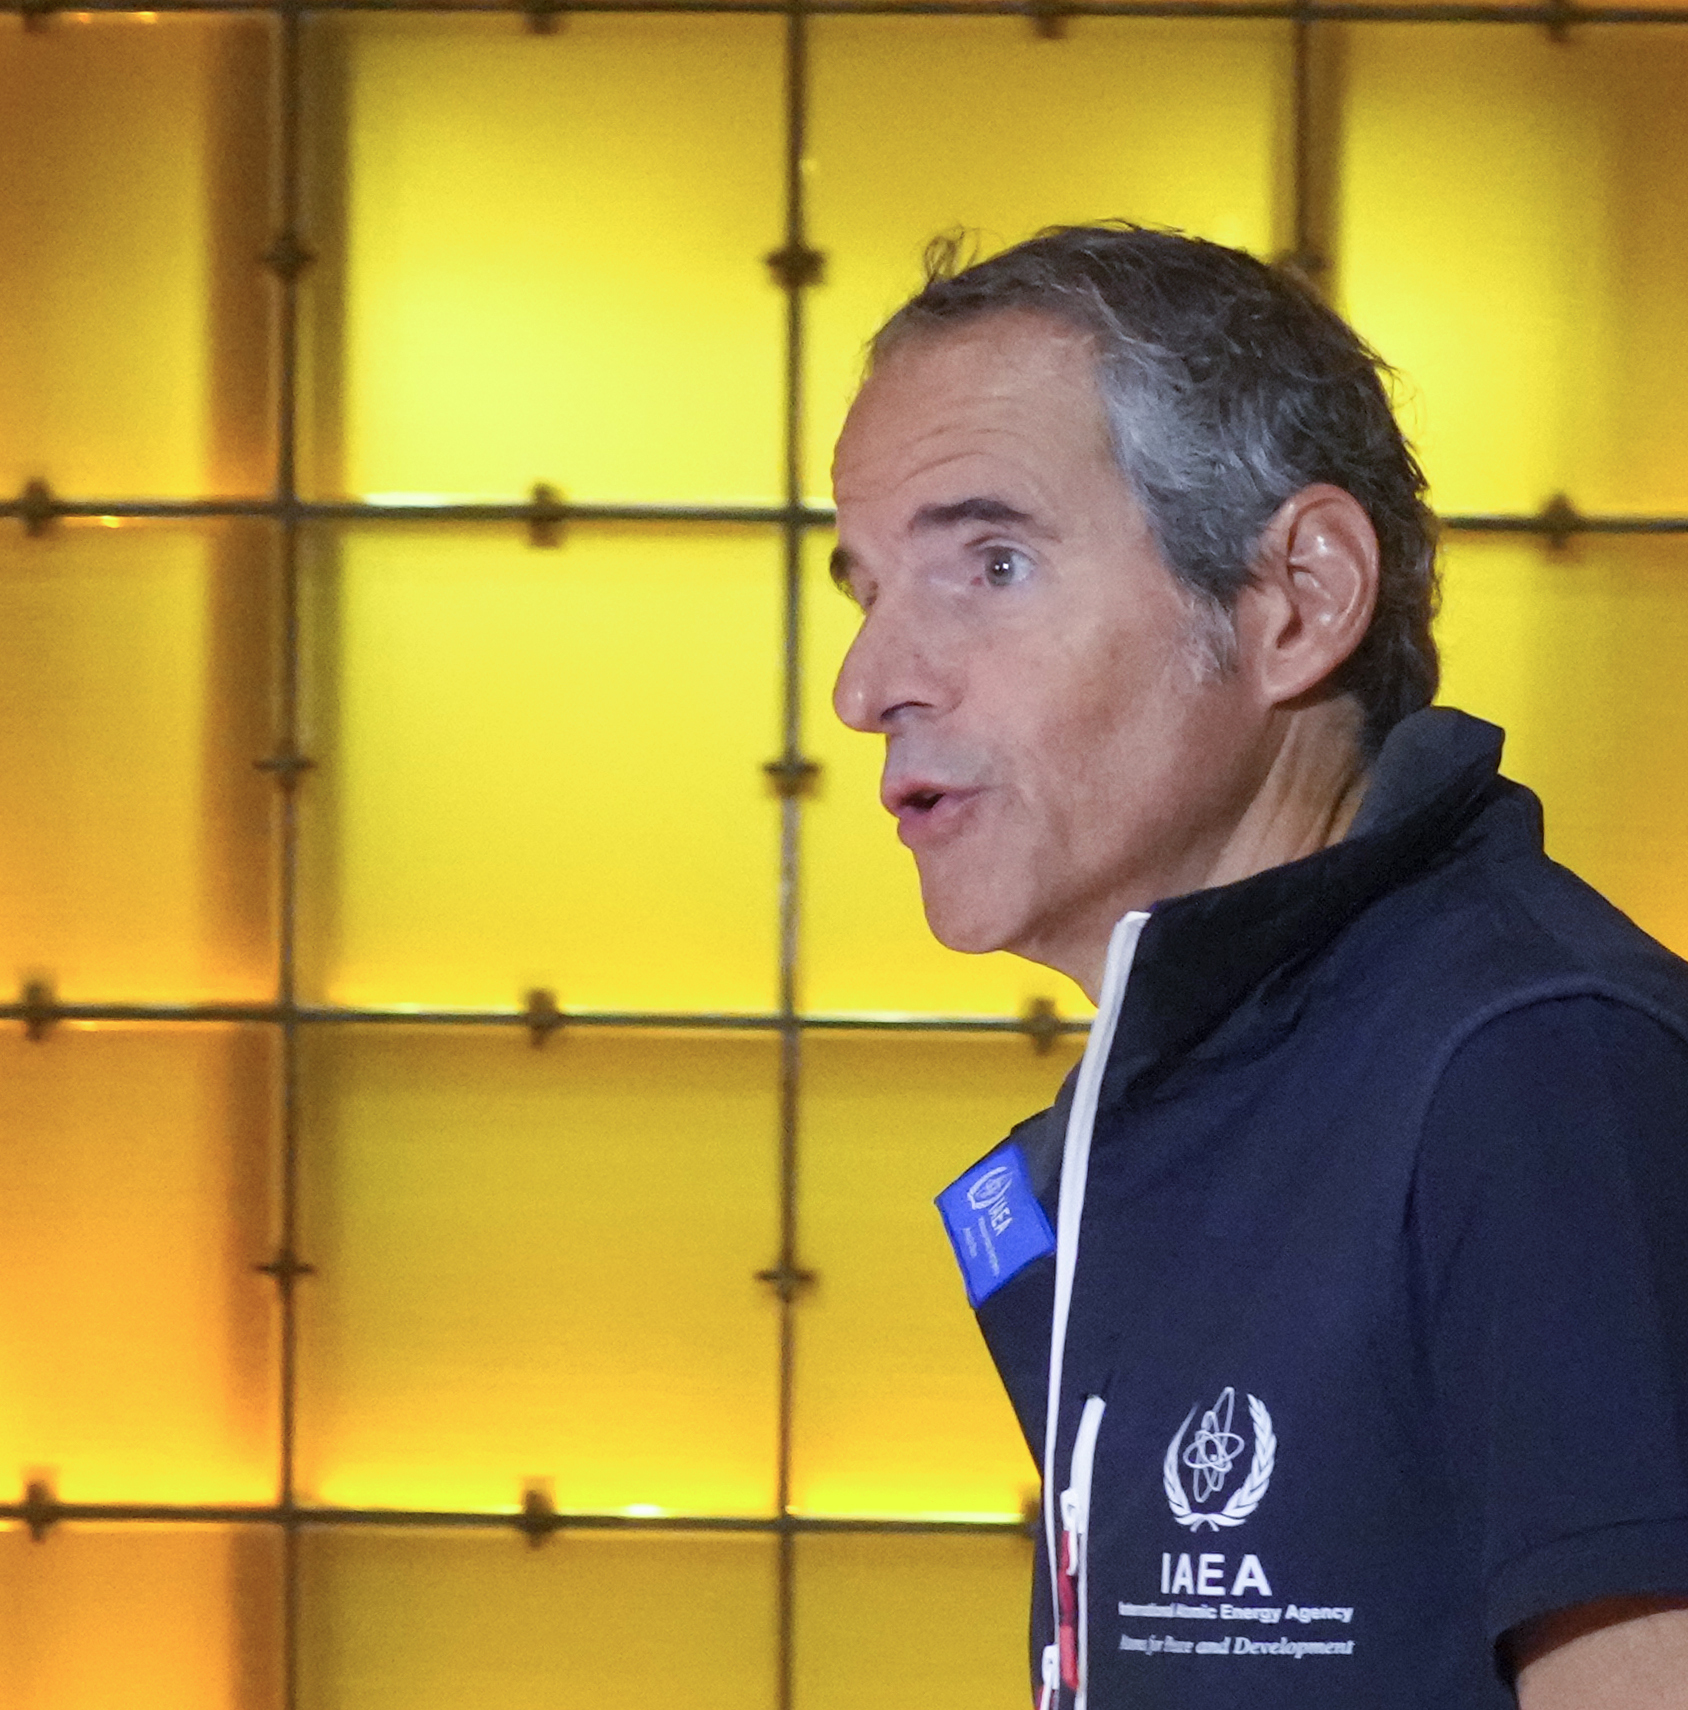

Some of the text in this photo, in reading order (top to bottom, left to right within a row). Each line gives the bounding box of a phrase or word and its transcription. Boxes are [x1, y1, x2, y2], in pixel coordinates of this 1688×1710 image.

[1160, 1552, 1273, 1597] IAEA
[1219, 1603, 1283, 1624] Energy
[1284, 1603, 1354, 1624] Agency
[1232, 1636, 1355, 1660] Development
